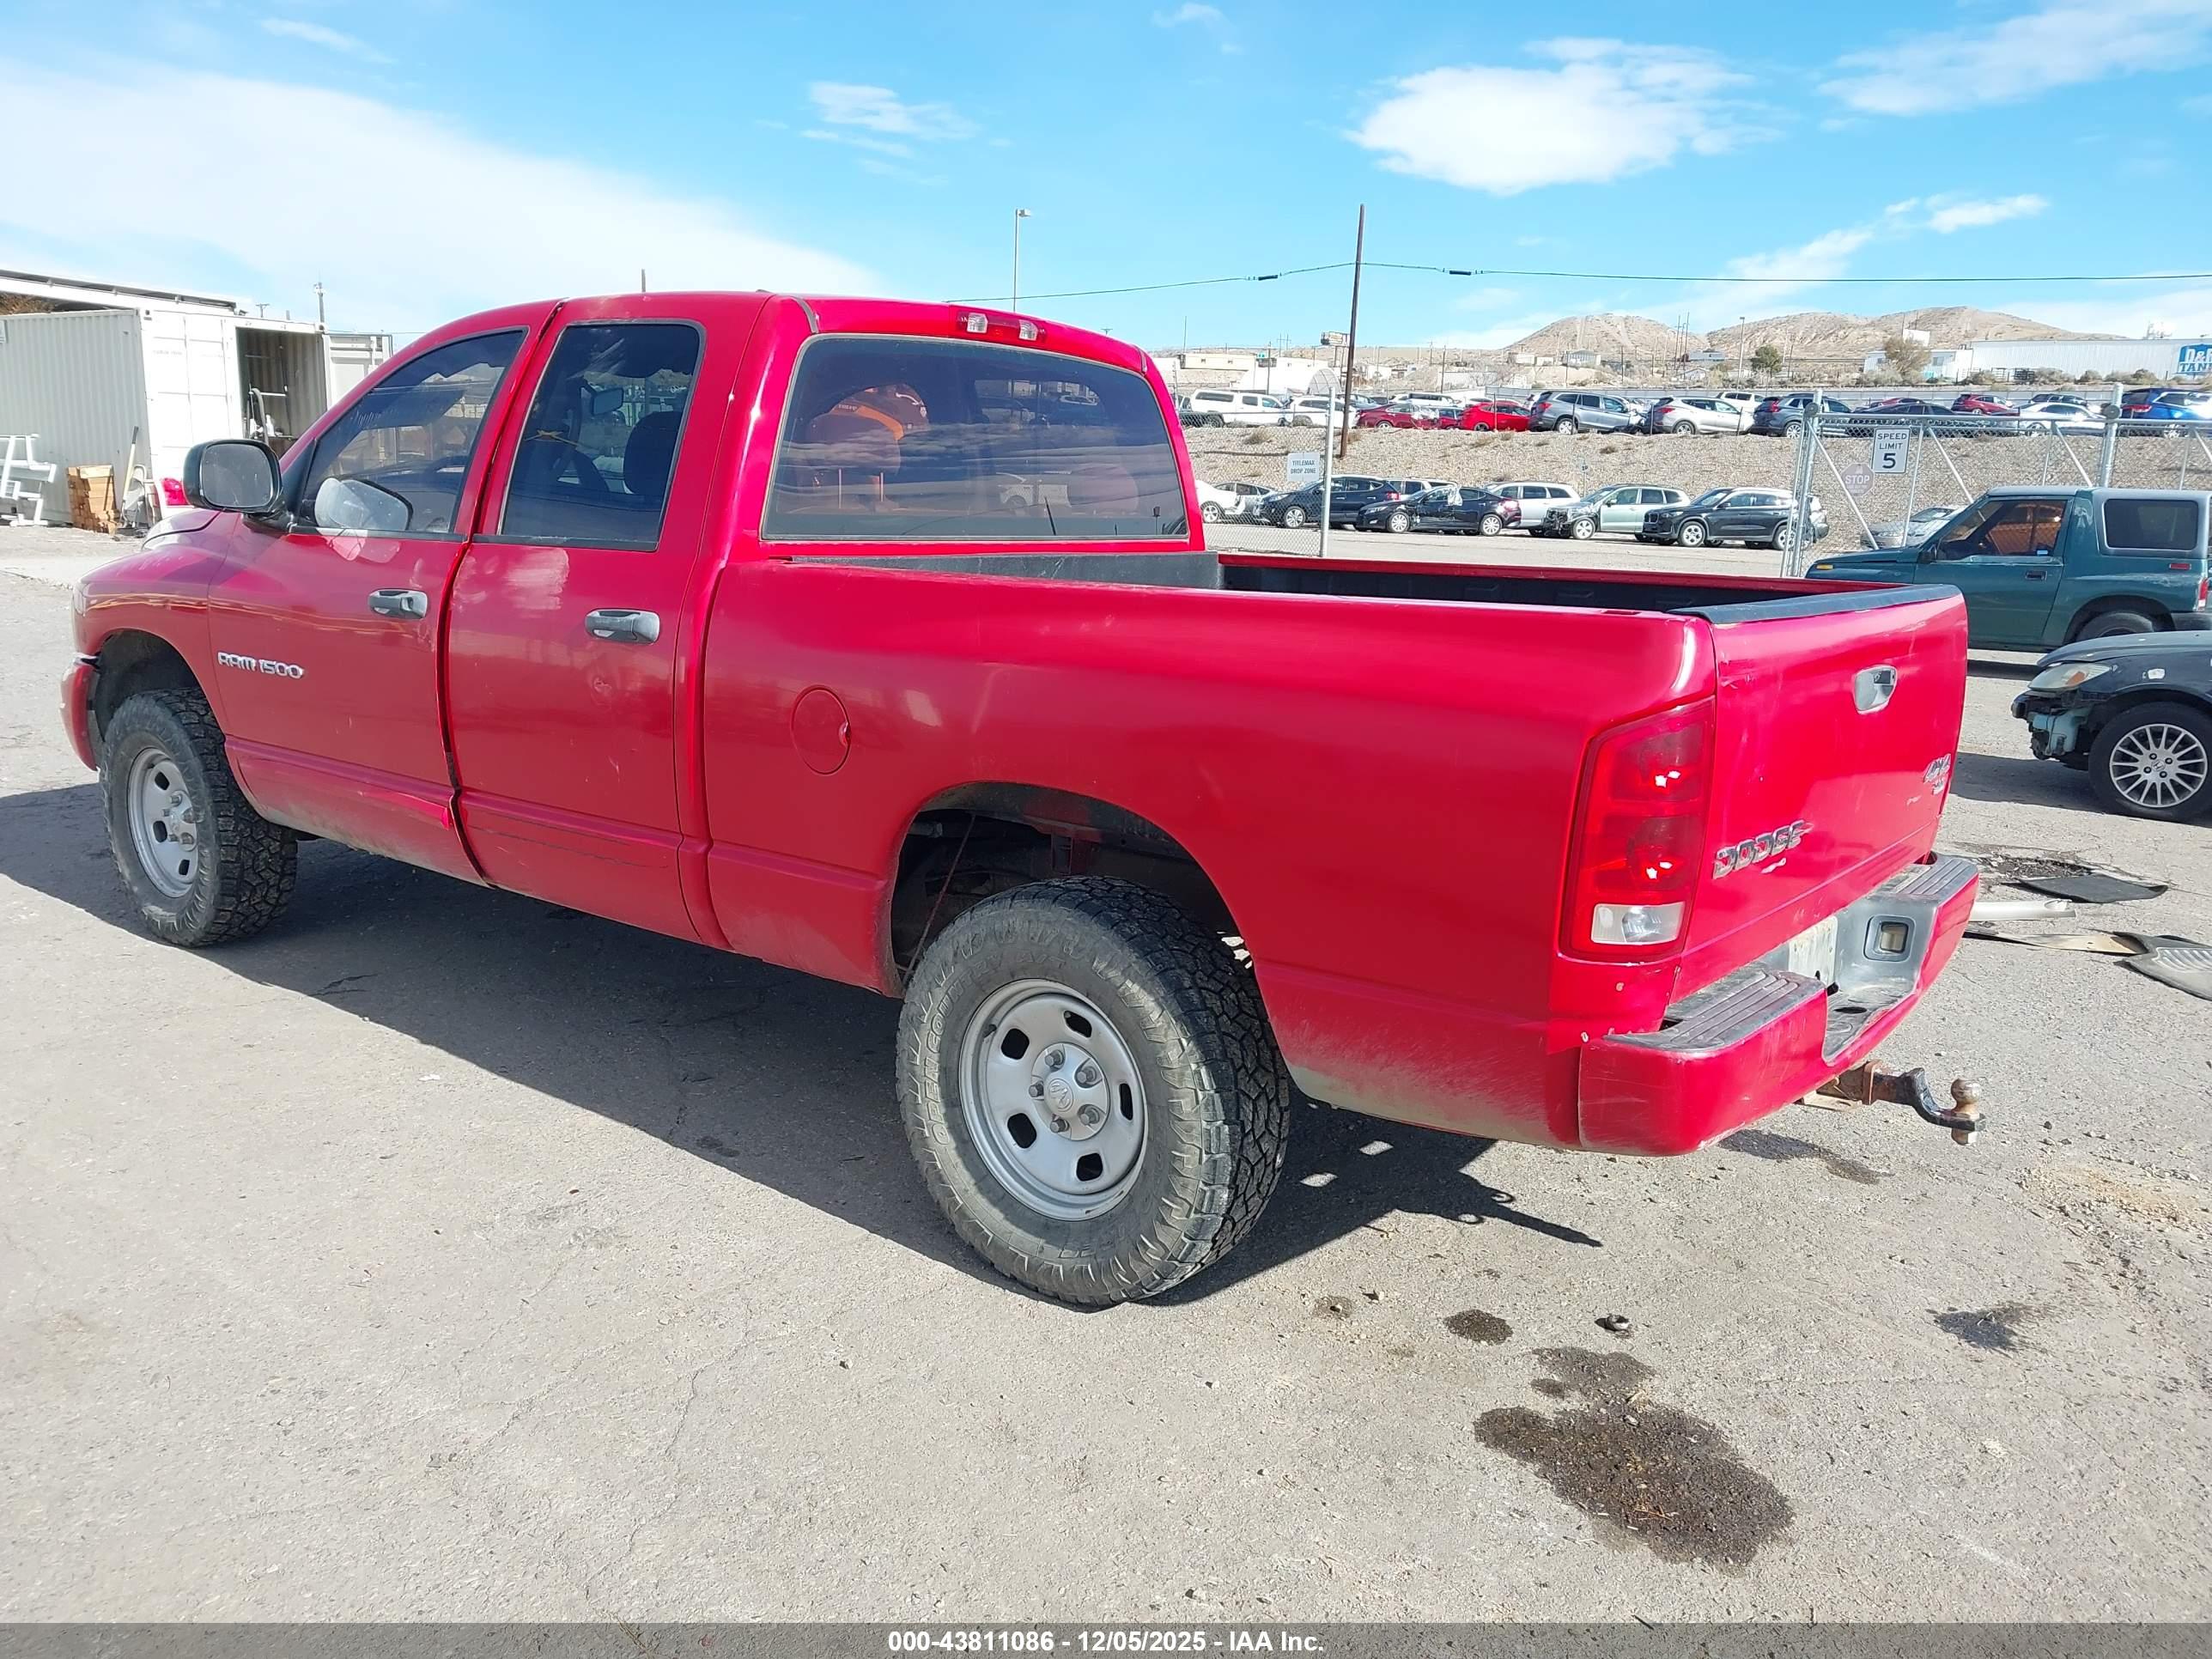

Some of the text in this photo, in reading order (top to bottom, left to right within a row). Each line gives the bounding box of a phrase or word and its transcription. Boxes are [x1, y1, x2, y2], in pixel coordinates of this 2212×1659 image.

[1881, 453, 1897, 469] 5
[1844, 474, 1870, 484] STOP
[217, 651, 305, 679] RAM 1500
[1712, 819, 1814, 880] DODGE
[924, 1056, 951, 1146] OPEN
